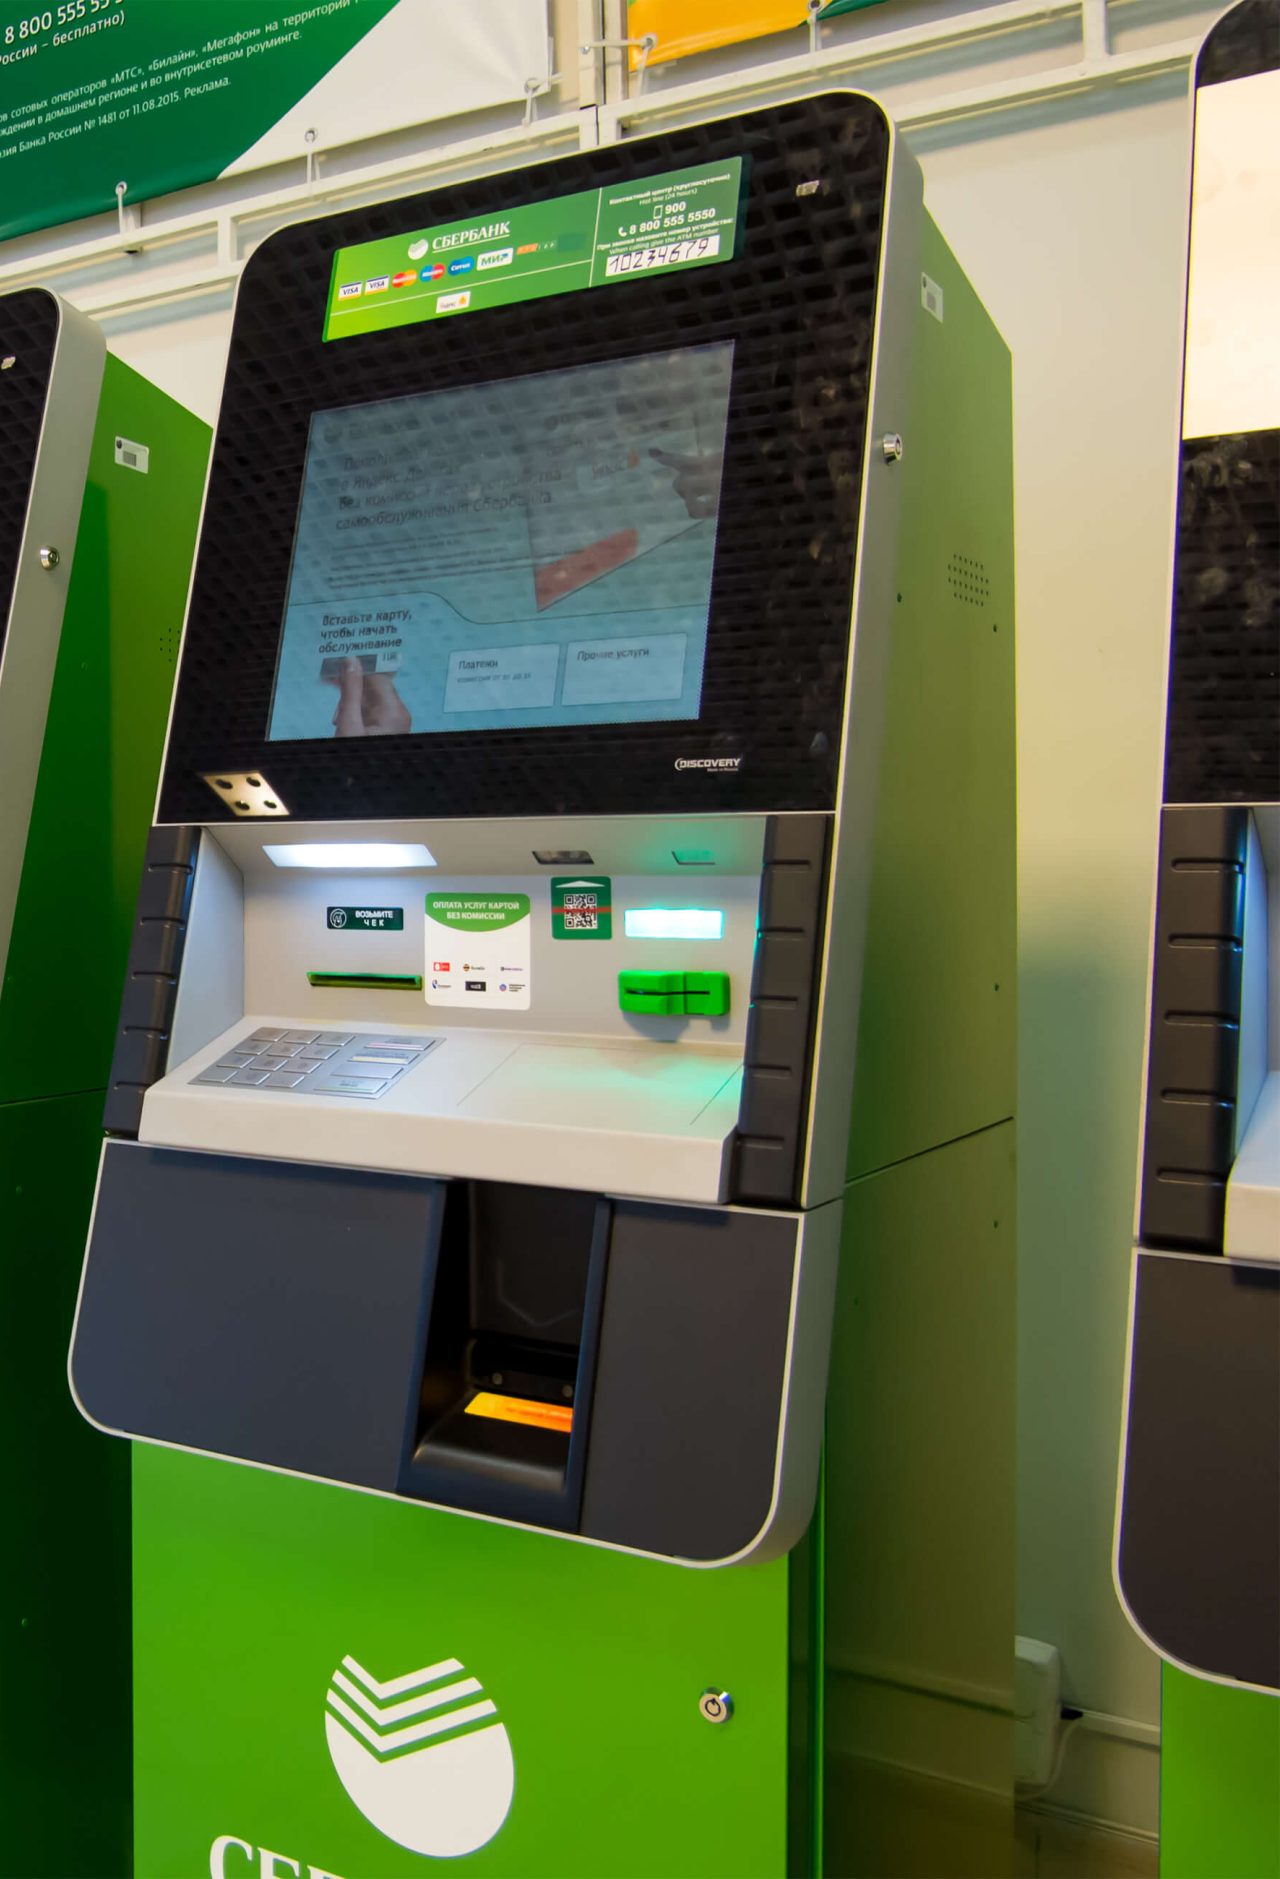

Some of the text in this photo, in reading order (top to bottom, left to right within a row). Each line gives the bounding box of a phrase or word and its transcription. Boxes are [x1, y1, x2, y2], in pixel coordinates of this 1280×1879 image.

[5, 26, 14, 44] 8
[19, 12, 52, 38] 800
[57, 0, 86, 25] 555
[53, 10, 125, 47] бесплатно)
[10, 100, 48, 118] сотовых
[51, 80, 107, 104] операторов
[202, 28, 261, 53] «Мегафон»
[265, 21, 278, 33] на
[282, 0, 350, 26] территории
[38, 116, 43, 124] в
[45, 99, 96, 122] домашнем
[98, 83, 138, 106] регионе
[141, 81, 147, 90] и
[150, 76, 162, 87] во
[165, 51, 243, 82] внутрисетевом
[247, 29, 302, 58] роуминге.
[19, 137, 46, 152] Банка
[48, 124, 82, 143] России
[98, 111, 116, 126] 1481
[119, 108, 130, 119] от
[665, 201, 686, 214] 900
[629, 207, 716, 235] 8 800 555 5550
[432, 221, 510, 250] СБЕРБАНК
[342, 286, 359, 296] VISA
[369, 280, 385, 289] VISA
[321, 624, 397, 640] чтобы начать
[319, 637, 403, 654] обслуживание
[677, 758, 741, 769] DISCOVERY
[433, 900, 520, 910] ОПЛАТА УСЛУГ КАРТОЙ
[355, 910, 394, 919] ВОЗЬМИТЕ
[447, 912, 505, 921] БЕЗ КОМИССИИ
